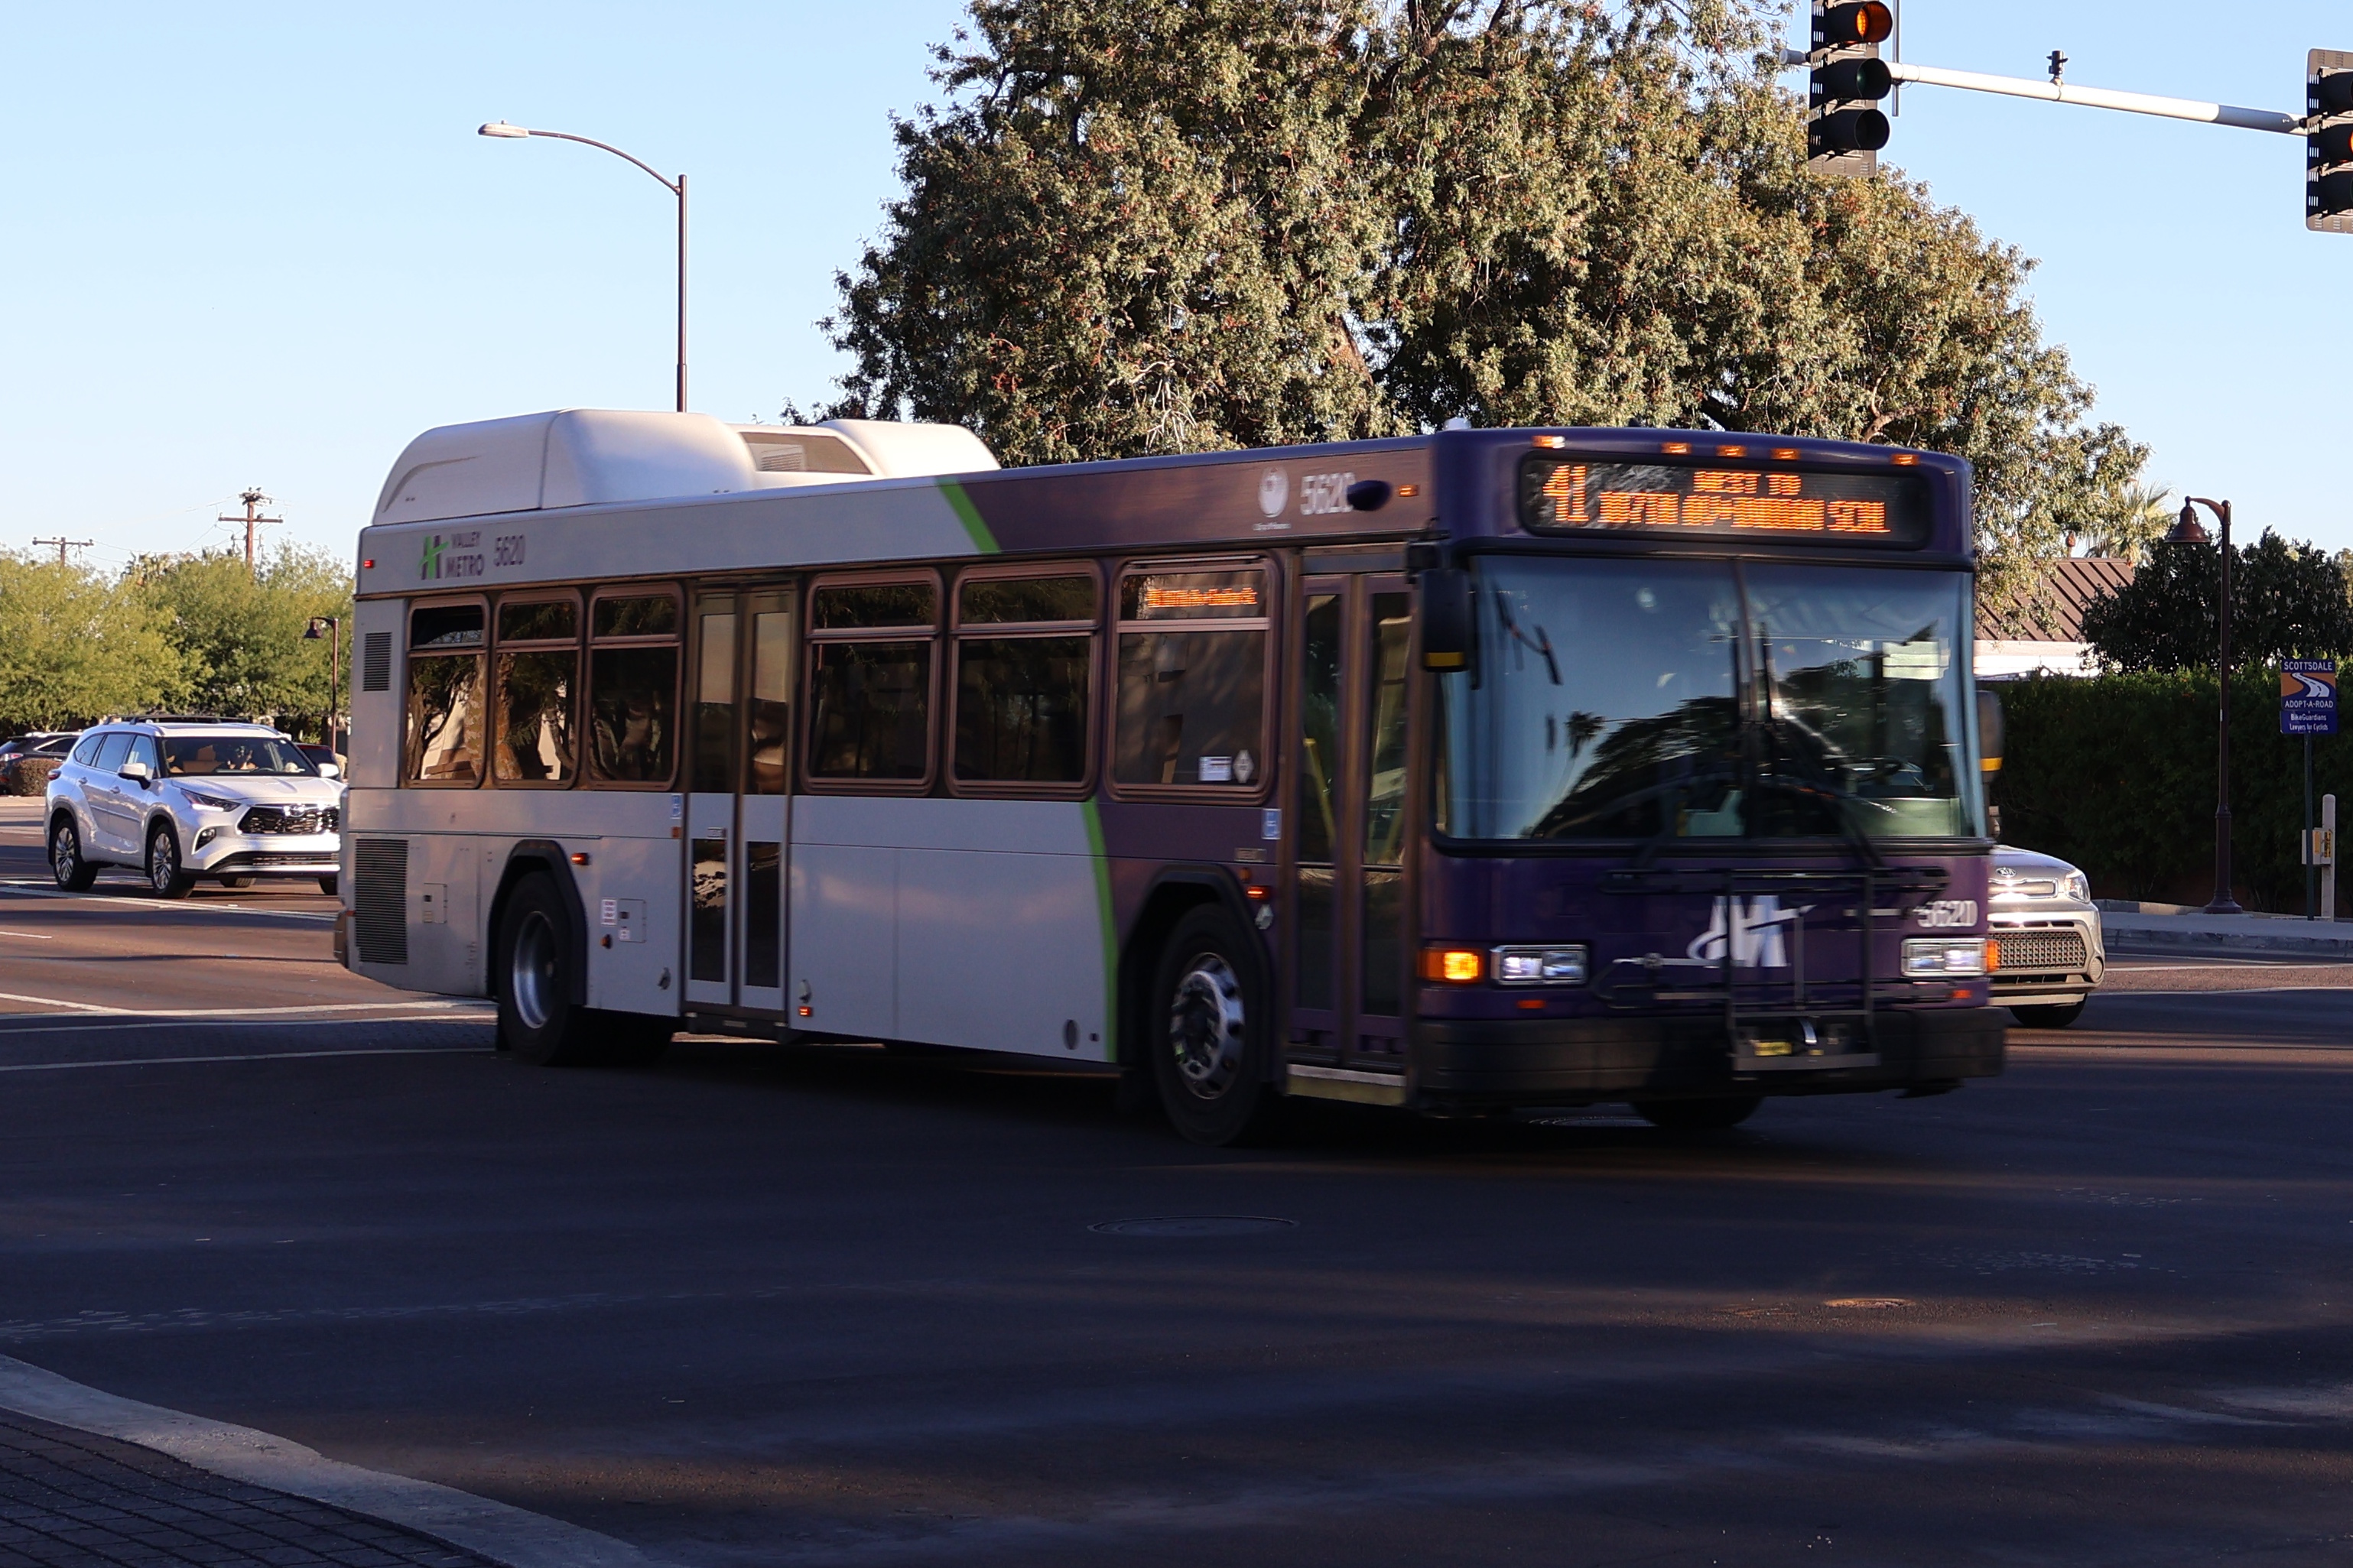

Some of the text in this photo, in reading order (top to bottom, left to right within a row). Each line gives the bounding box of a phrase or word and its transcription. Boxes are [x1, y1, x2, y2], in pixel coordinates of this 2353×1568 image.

[1542, 465, 1589, 521] 41
[450, 531, 482, 550] VALLEY
[493, 534, 525, 567] 5620
[445, 554, 485, 579] METRO
[2283, 661, 2333, 671] SCOTTSDALE
[1914, 900, 1978, 928] 5620
